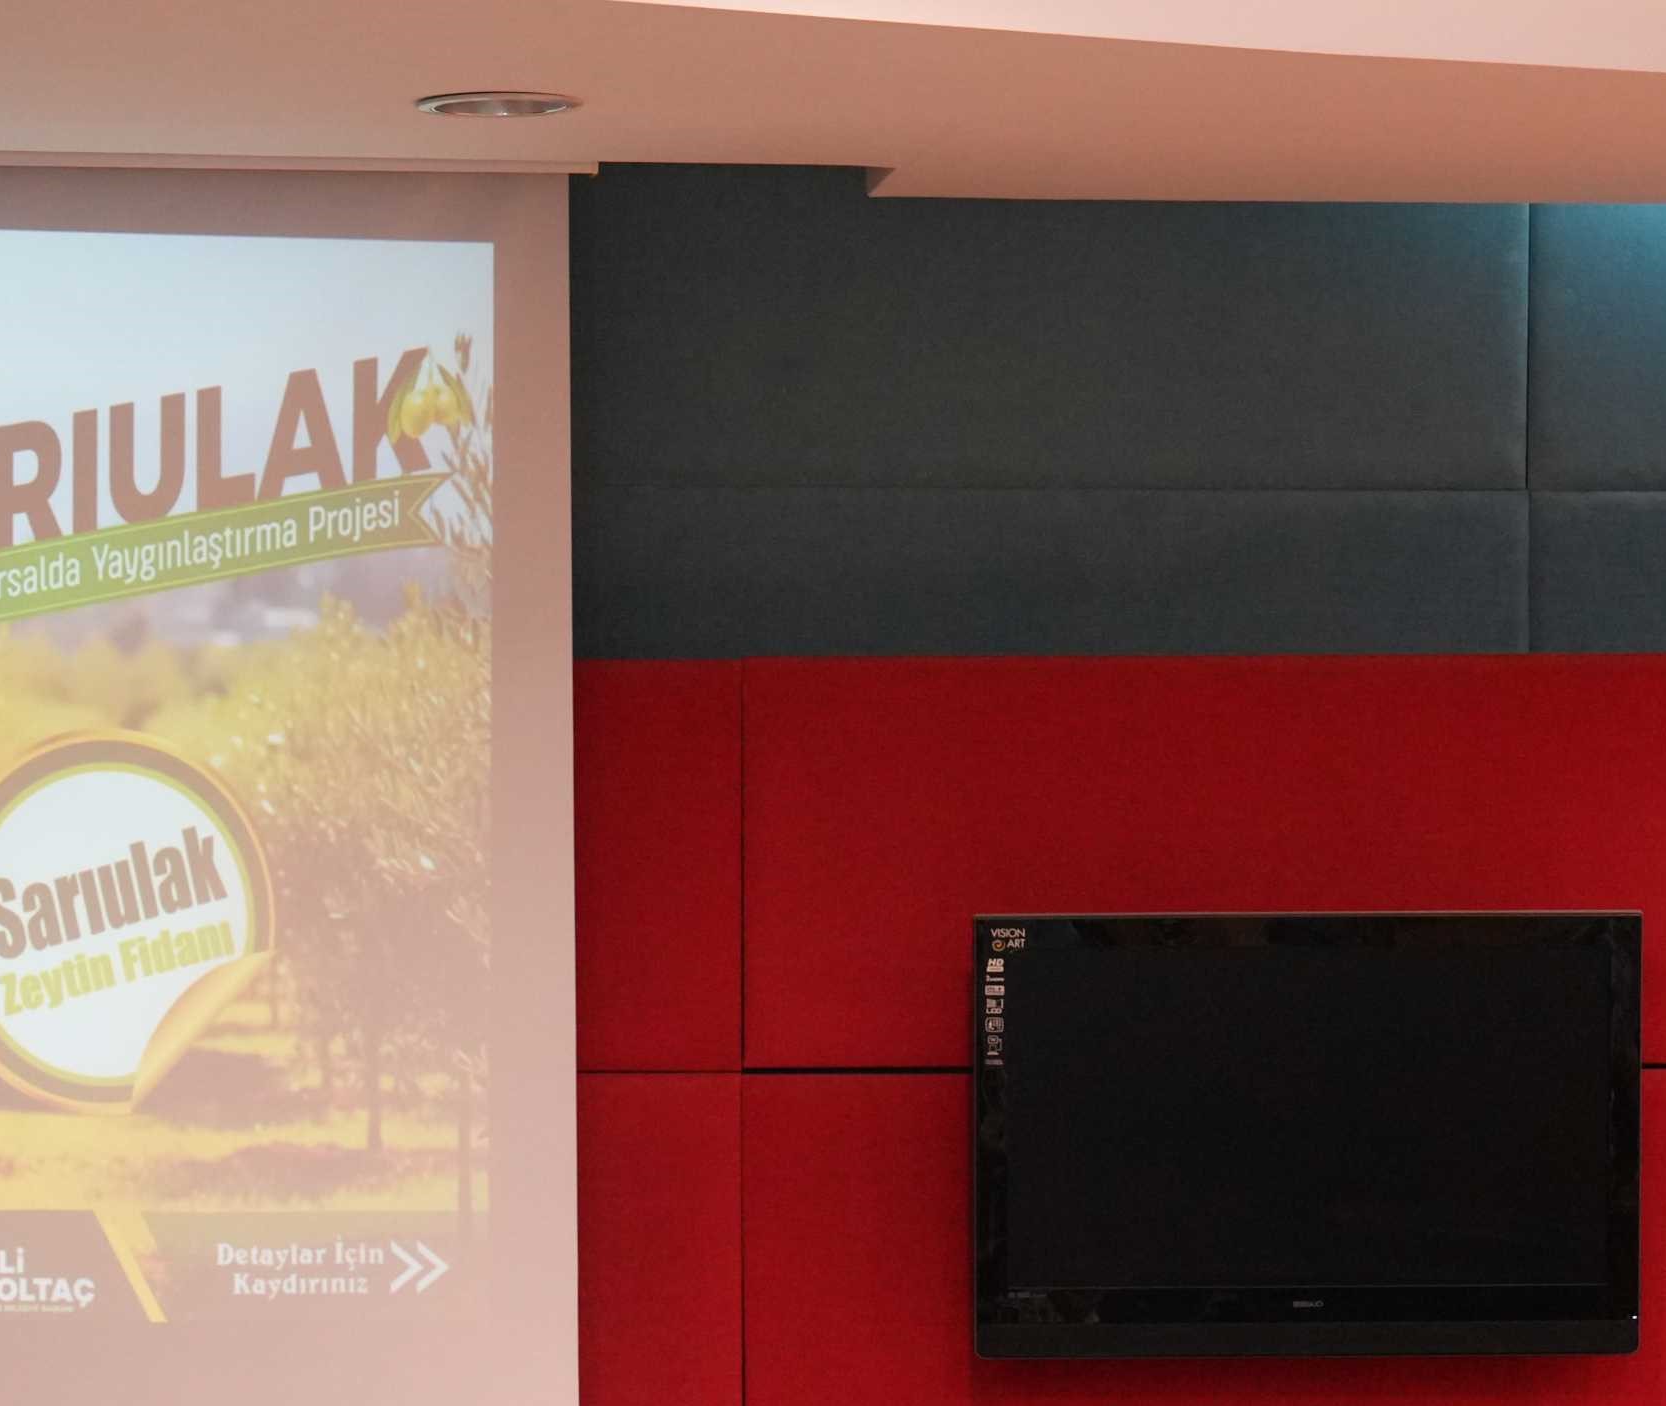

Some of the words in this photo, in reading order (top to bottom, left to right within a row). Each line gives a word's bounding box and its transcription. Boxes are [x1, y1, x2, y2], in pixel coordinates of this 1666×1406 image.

[91, 518, 297, 584] Yaygınlaştırma
[308, 490, 400, 542] Projesi
[990, 927, 1026, 938] VISION
[1006, 938, 1026, 949] ART
[117, 920, 234, 983] Fidanı
[216, 1242, 328, 1271] Detaylar
[334, 1234, 384, 1271] İçin
[233, 1273, 369, 1301] Kaydırınız
